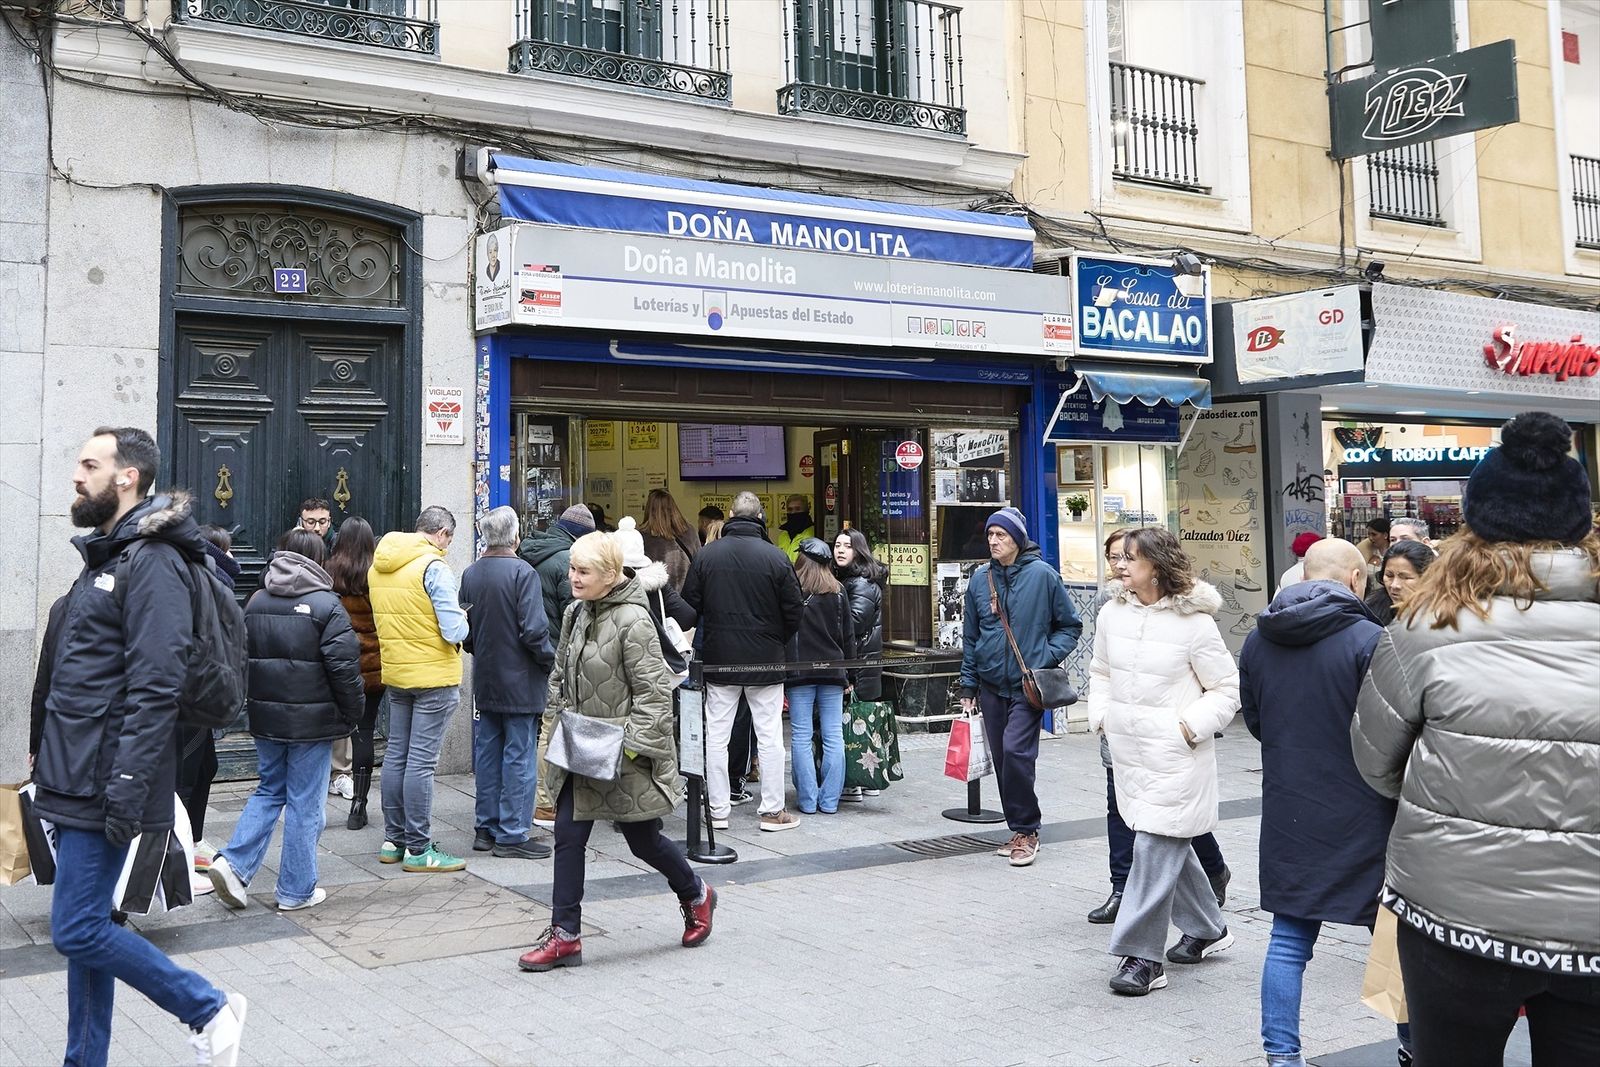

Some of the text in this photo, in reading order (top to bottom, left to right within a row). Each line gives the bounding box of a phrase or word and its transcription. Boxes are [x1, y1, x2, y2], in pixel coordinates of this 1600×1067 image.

[667, 210, 912, 257] DOÑA MANOLITA
[624, 245, 797, 285] Doña Manolita
[280, 273, 300, 288] 22
[853, 279, 996, 302] www.loteriamanolita.com
[1092, 274, 1117, 304] L
[1122, 276, 1161, 308] Casa
[523, 305, 536, 313] 24h
[633, 296, 854, 325] Loterías y Apuestas del Estado
[1318, 308, 1344, 326] GD
[1083, 305, 1203, 346] BACALAO
[428, 388, 461, 397] VIGILADO
[1180, 409, 1258, 421] .cazadosdiez.com
[631, 425, 656, 434] 13440
[1391, 448, 1445, 462] ROBOT
[1180, 528, 1224, 542] Calzados
[1406, 906, 1444, 942] LOVE
[1450, 929, 1504, 959] LOVE
[1511, 945, 1573, 972] LOVE
